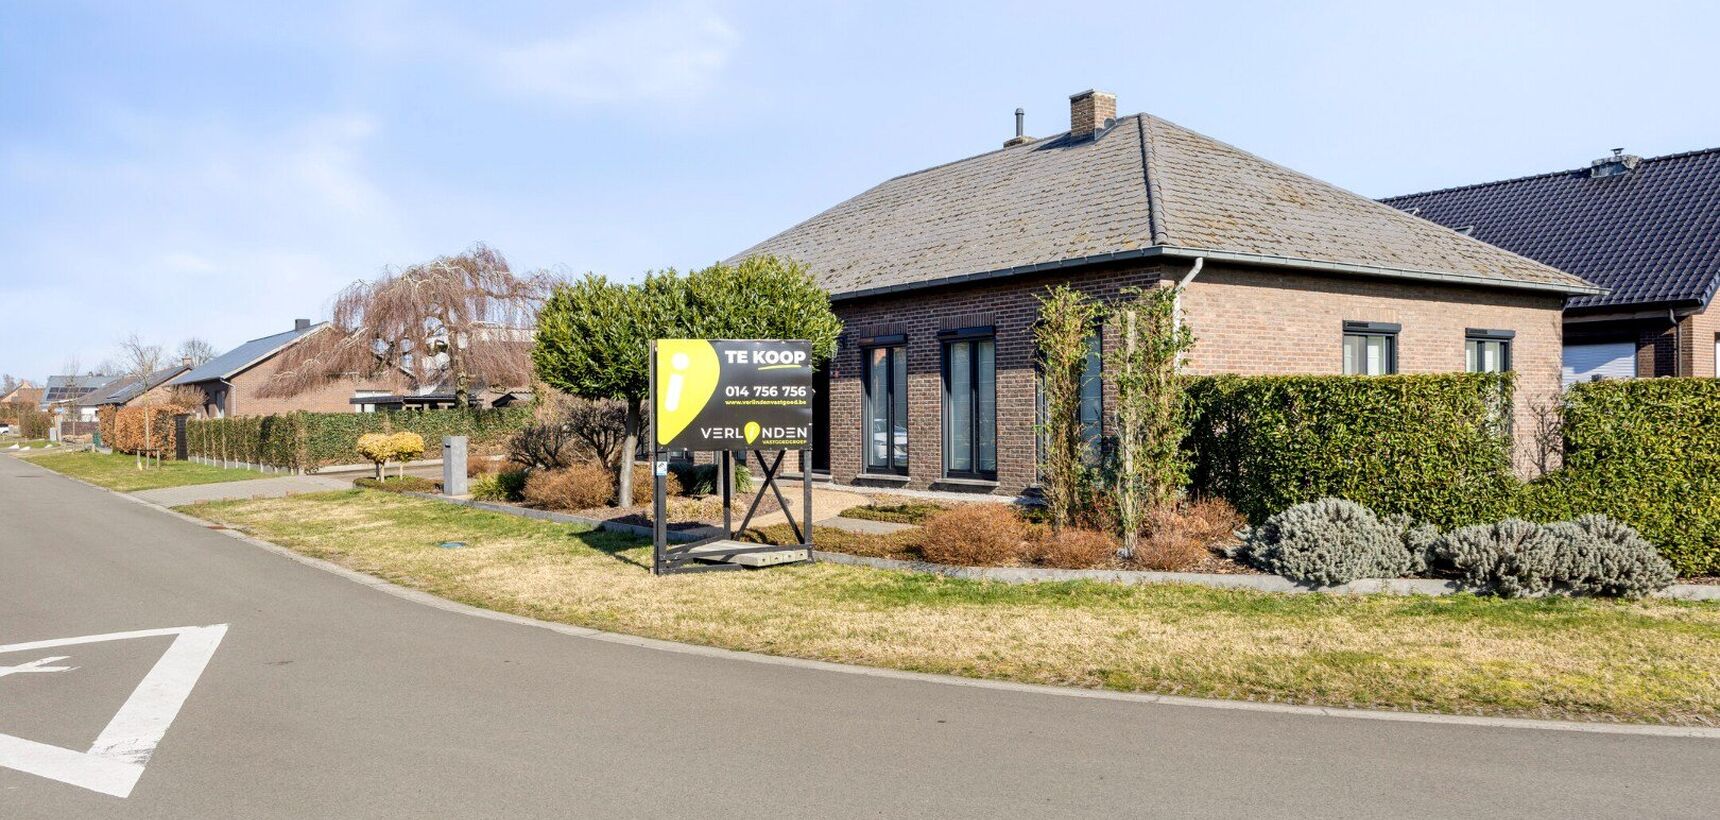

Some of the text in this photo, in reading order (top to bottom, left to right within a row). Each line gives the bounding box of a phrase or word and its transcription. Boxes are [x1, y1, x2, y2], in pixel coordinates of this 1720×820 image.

[724, 350, 806, 364] TE KOOP
[725, 386, 807, 397] 014 756 756
